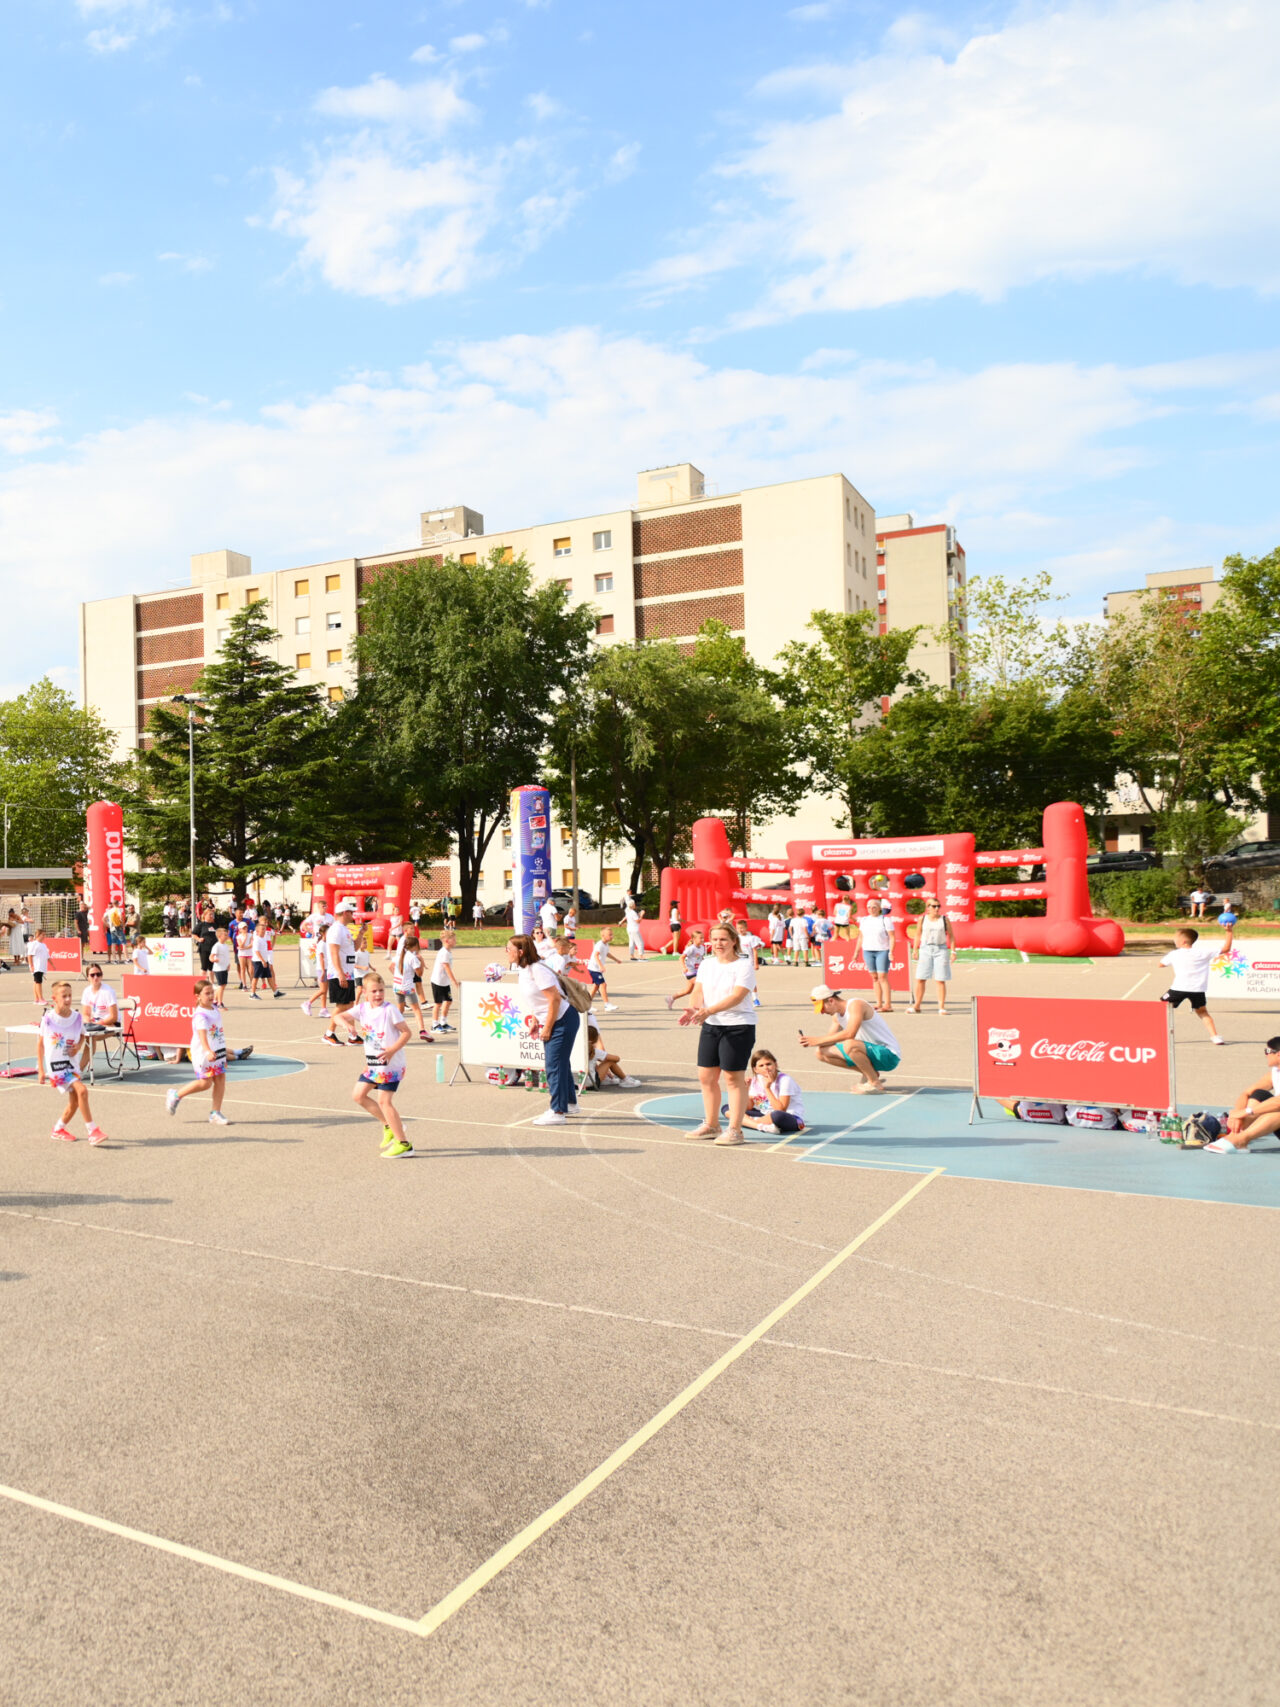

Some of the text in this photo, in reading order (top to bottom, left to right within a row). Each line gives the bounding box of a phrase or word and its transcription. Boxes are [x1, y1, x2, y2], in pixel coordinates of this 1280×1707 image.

[824, 848, 853, 856] plazma
[144, 1002, 195, 1018] Coca-Cola CU
[520, 1042, 540, 1050] IGRE
[520, 1051, 546, 1060] MLAD
[1030, 1038, 1156, 1064] Coca-Cola CUP
